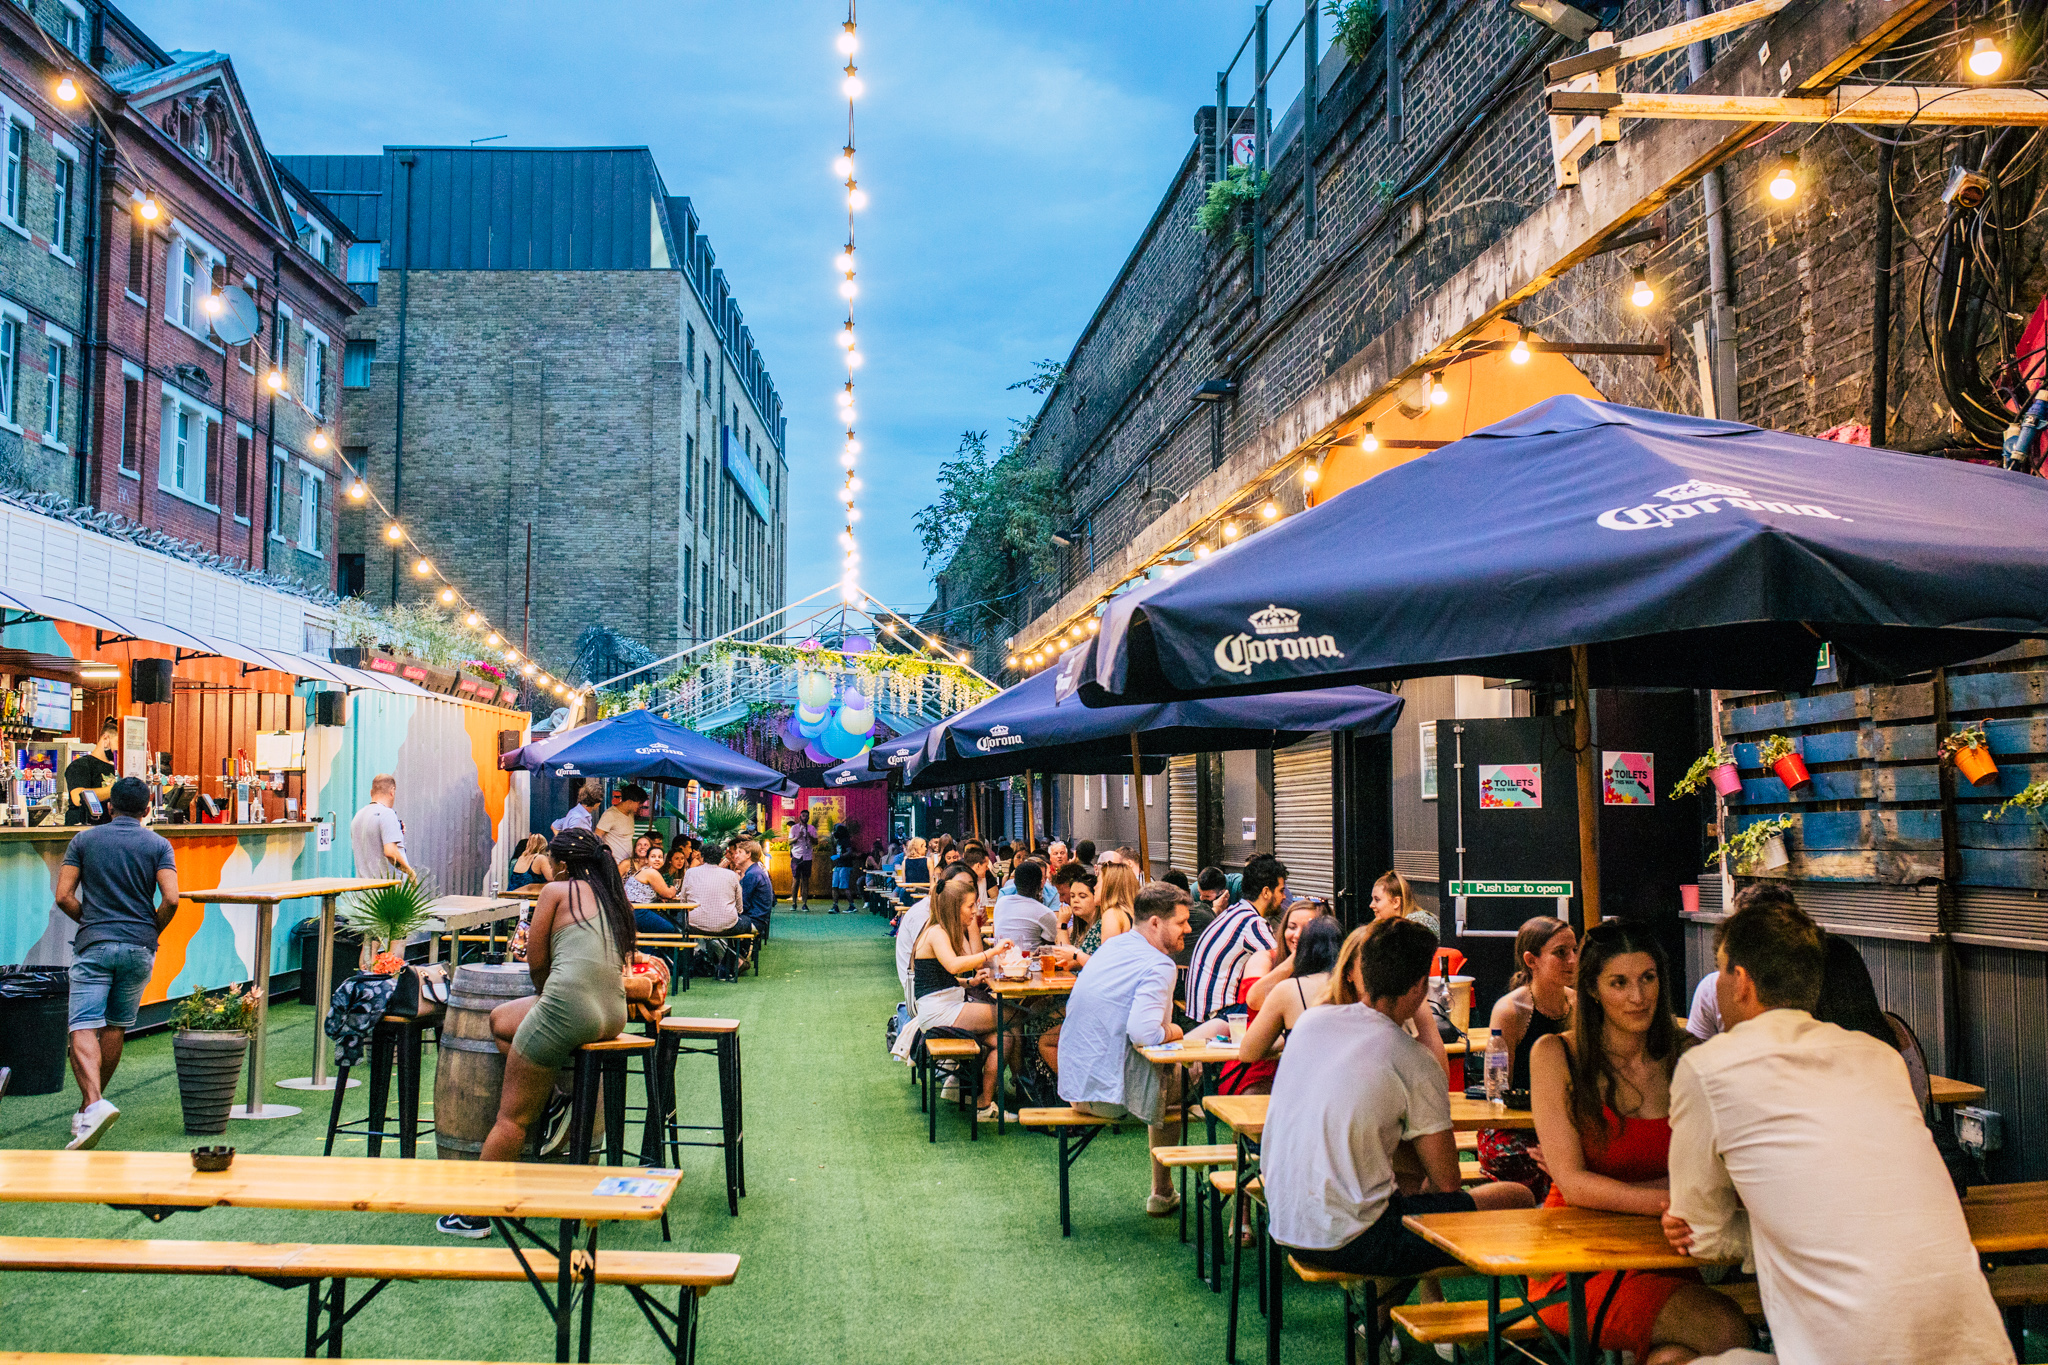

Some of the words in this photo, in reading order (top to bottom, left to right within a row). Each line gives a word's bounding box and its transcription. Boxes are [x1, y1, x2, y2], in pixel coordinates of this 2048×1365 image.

[1597, 498, 1852, 530] Corona
[1214, 632, 1344, 675] Corona
[976, 733, 1023, 751] Corona
[635, 747, 686, 757] Corona
[887, 755, 909, 766] Coro
[555, 768, 581, 777] Corona
[1615, 770, 1647, 779] TOILETS
[835, 775, 858, 785] Corona
[1494, 779, 1533, 787] TOILETS
[1476, 883, 1501, 893] Push
[1504, 883, 1521, 893] bar
[1523, 884, 1534, 893] to
[1537, 885, 1563, 895] open
